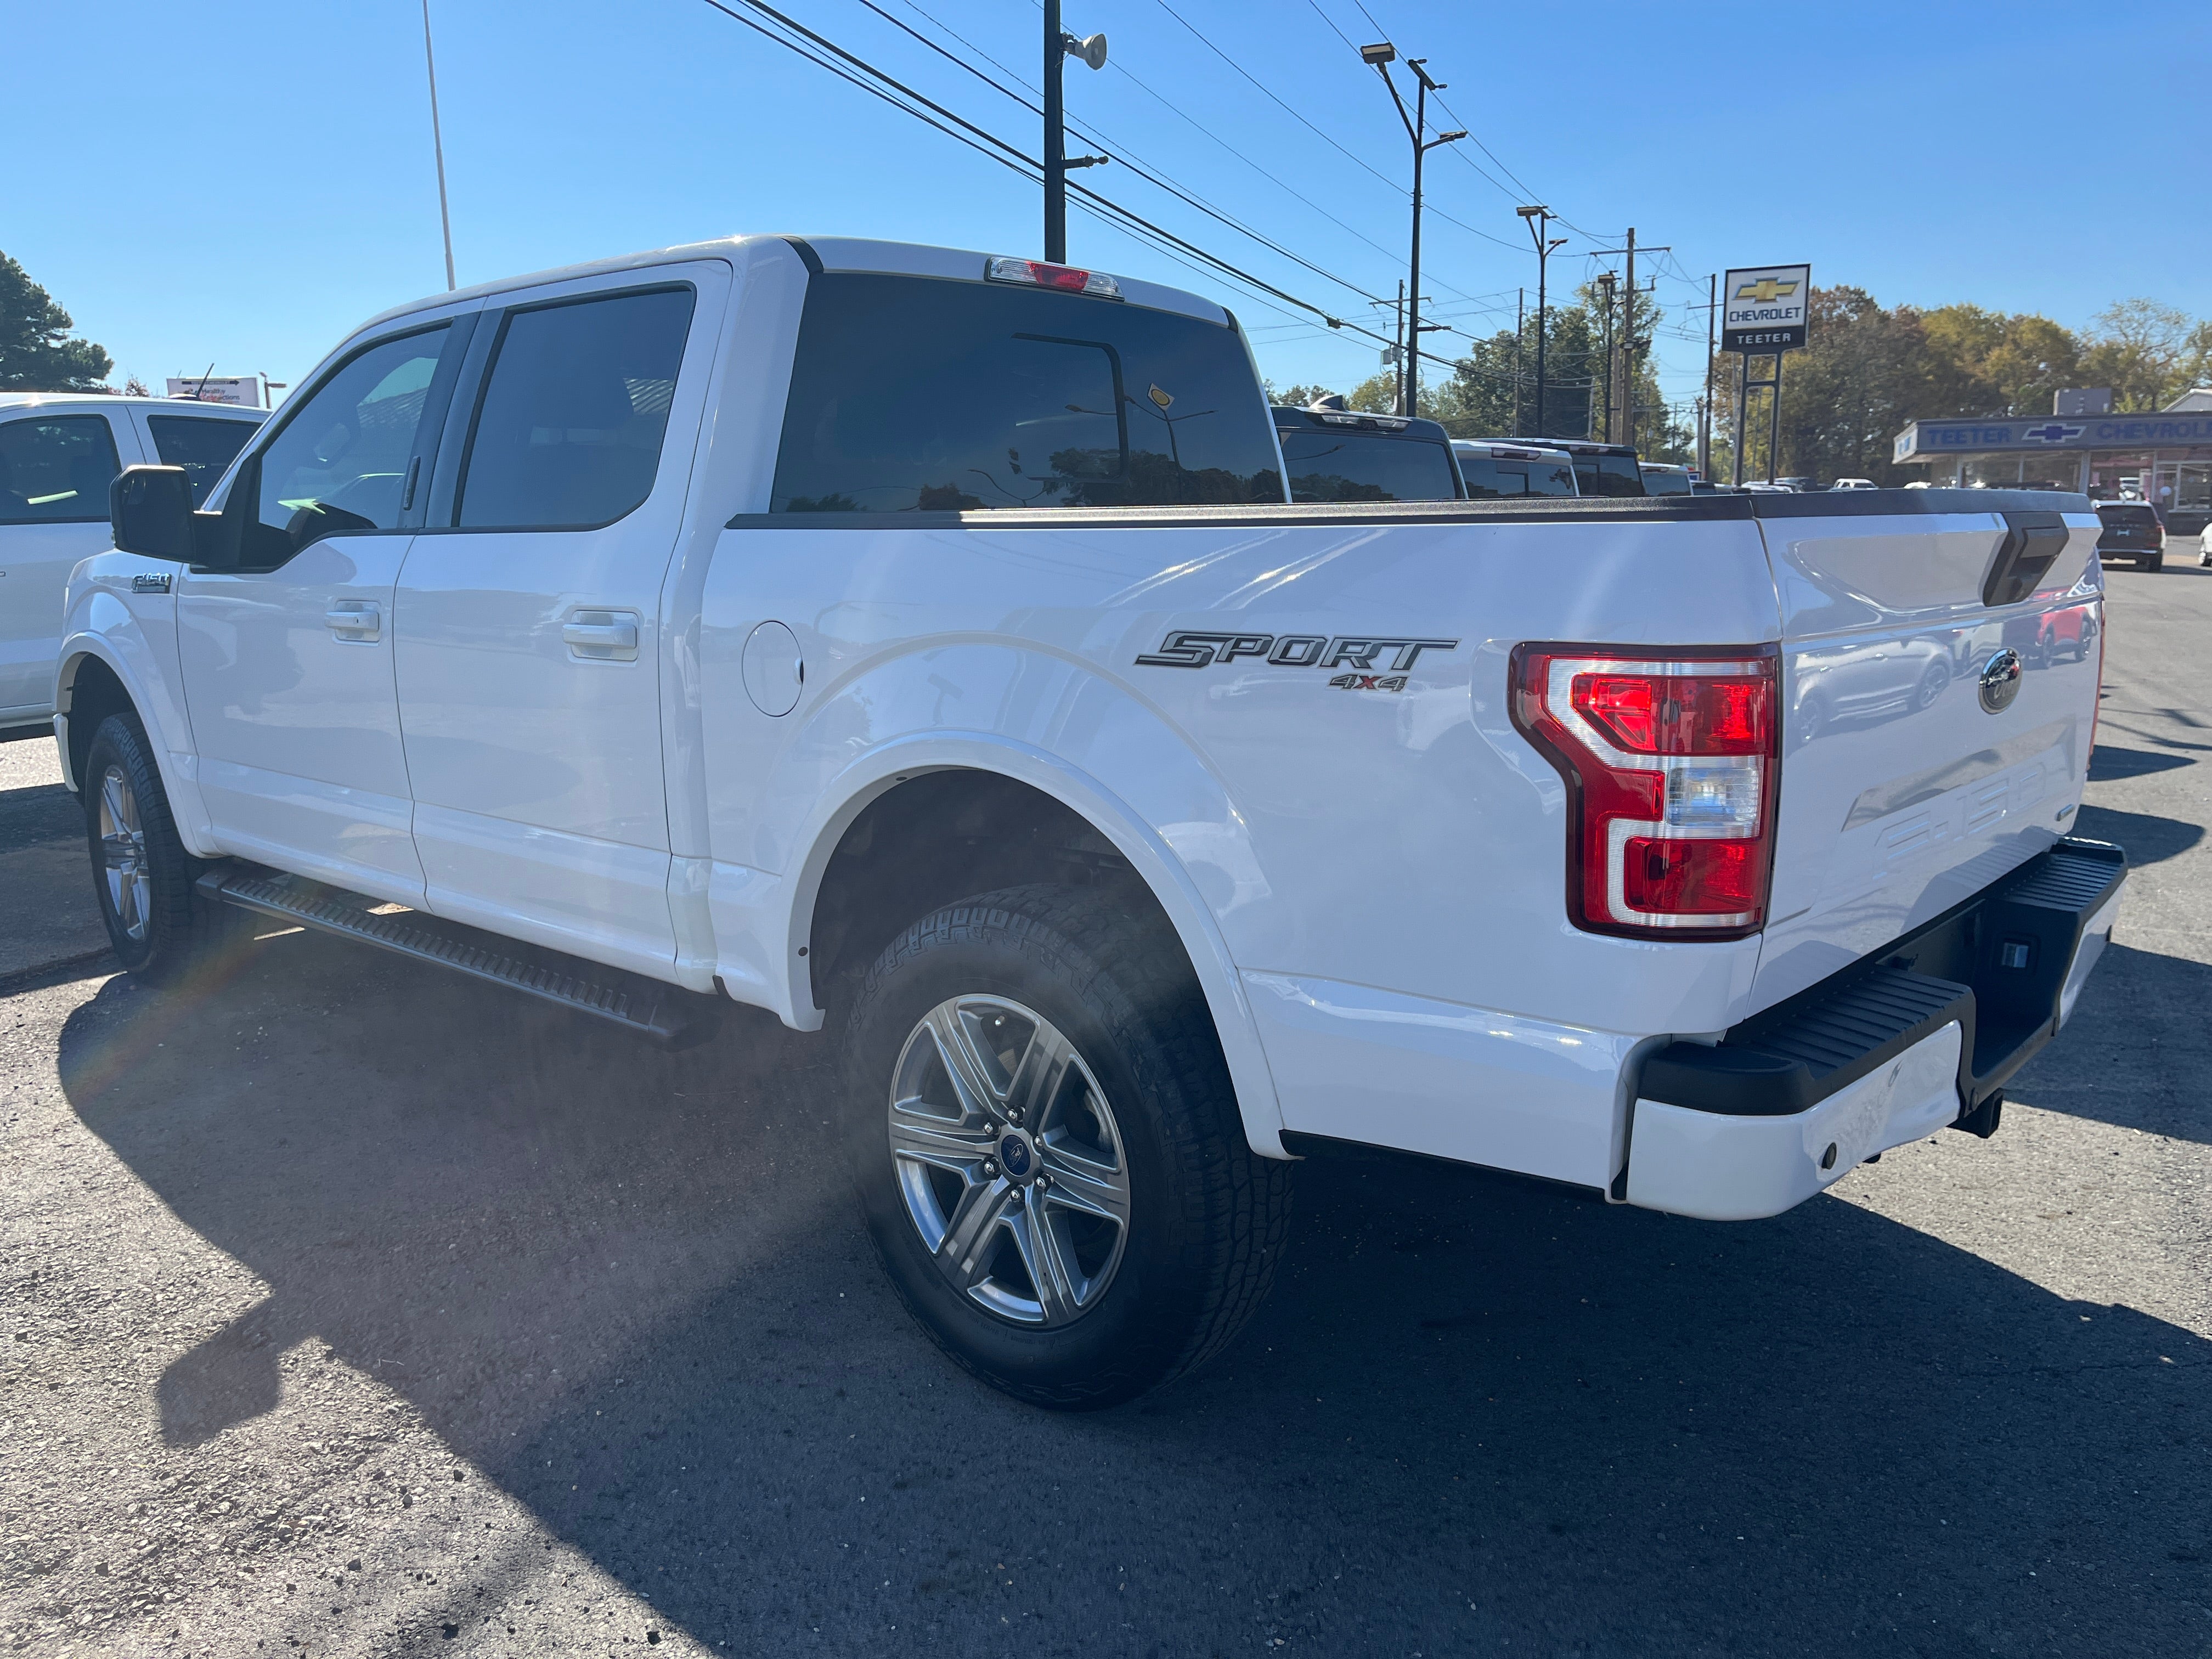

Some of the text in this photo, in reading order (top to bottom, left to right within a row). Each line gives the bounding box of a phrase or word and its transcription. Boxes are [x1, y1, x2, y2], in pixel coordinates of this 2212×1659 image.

[1729, 307, 1801, 322] CHEVROLET
[1737, 332, 1791, 345] TEETER
[1927, 427, 2012, 444] TEETER
[1133, 630, 1462, 670] SPORT
